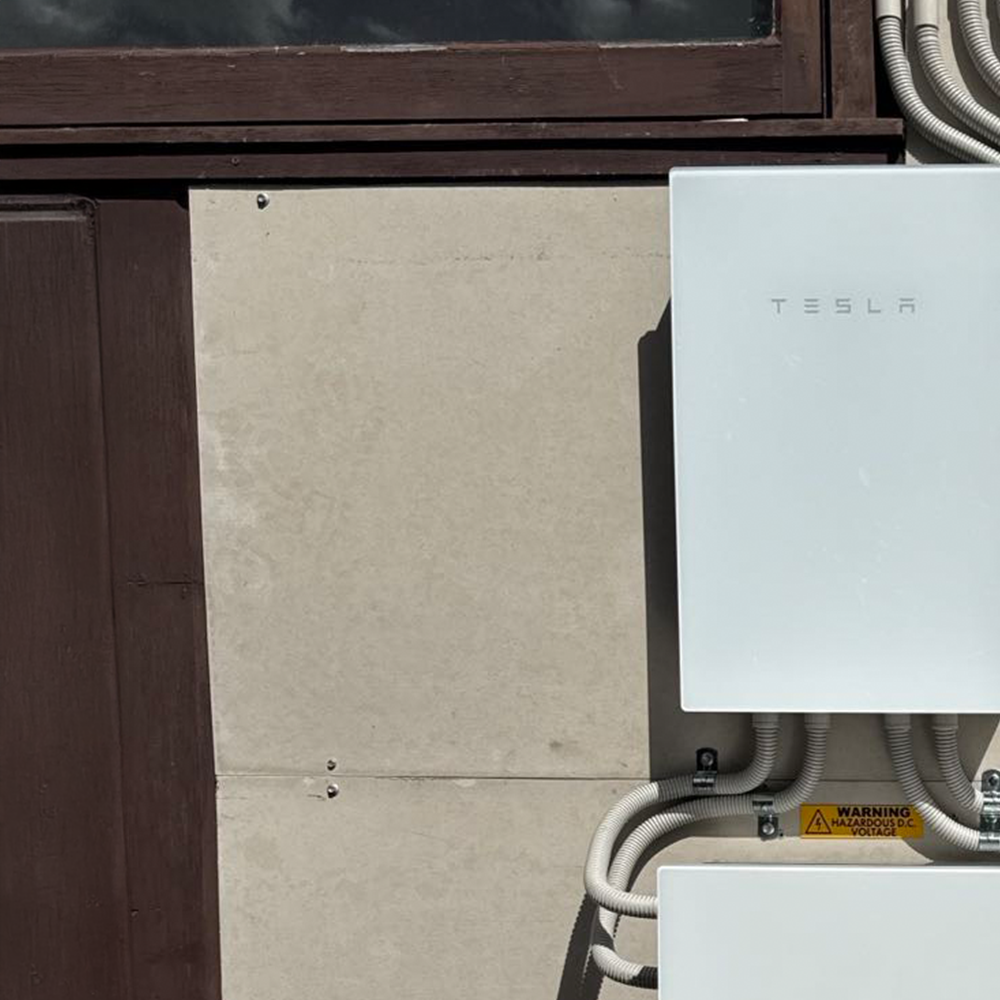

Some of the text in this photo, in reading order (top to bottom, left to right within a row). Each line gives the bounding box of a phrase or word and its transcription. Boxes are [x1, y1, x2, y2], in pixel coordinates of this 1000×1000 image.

[771, 298, 915, 314] TESLA
[837, 807, 911, 818] WARNING
[831, 818, 895, 828] HAZARDOUS
[851, 827, 897, 837] VOLTAGE
